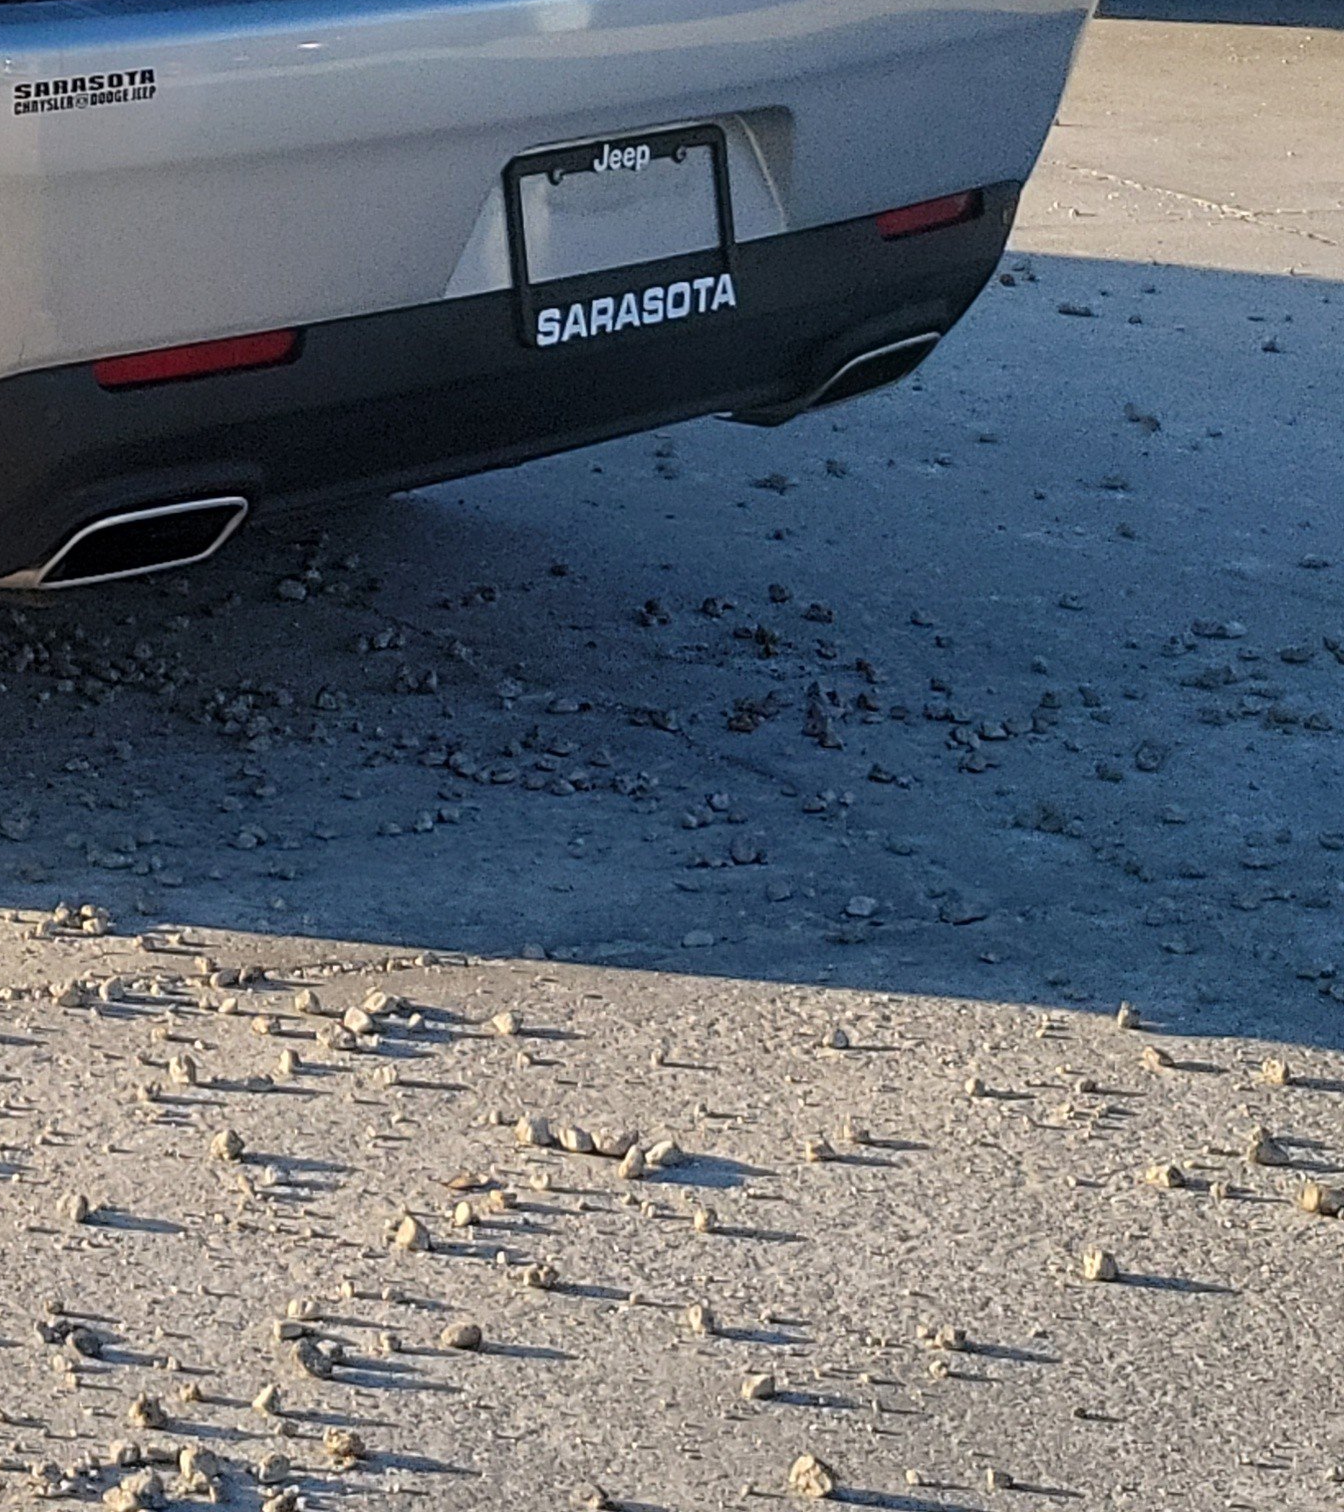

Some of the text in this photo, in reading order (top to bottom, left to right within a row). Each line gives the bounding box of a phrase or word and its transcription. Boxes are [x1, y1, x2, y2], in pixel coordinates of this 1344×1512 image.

[14, 68, 156, 100] SARASOTA
[14, 85, 157, 116] CHRYSLER DODGE JEEP
[593, 143, 651, 172] Jeep
[535, 273, 737, 347] SARASOTA
